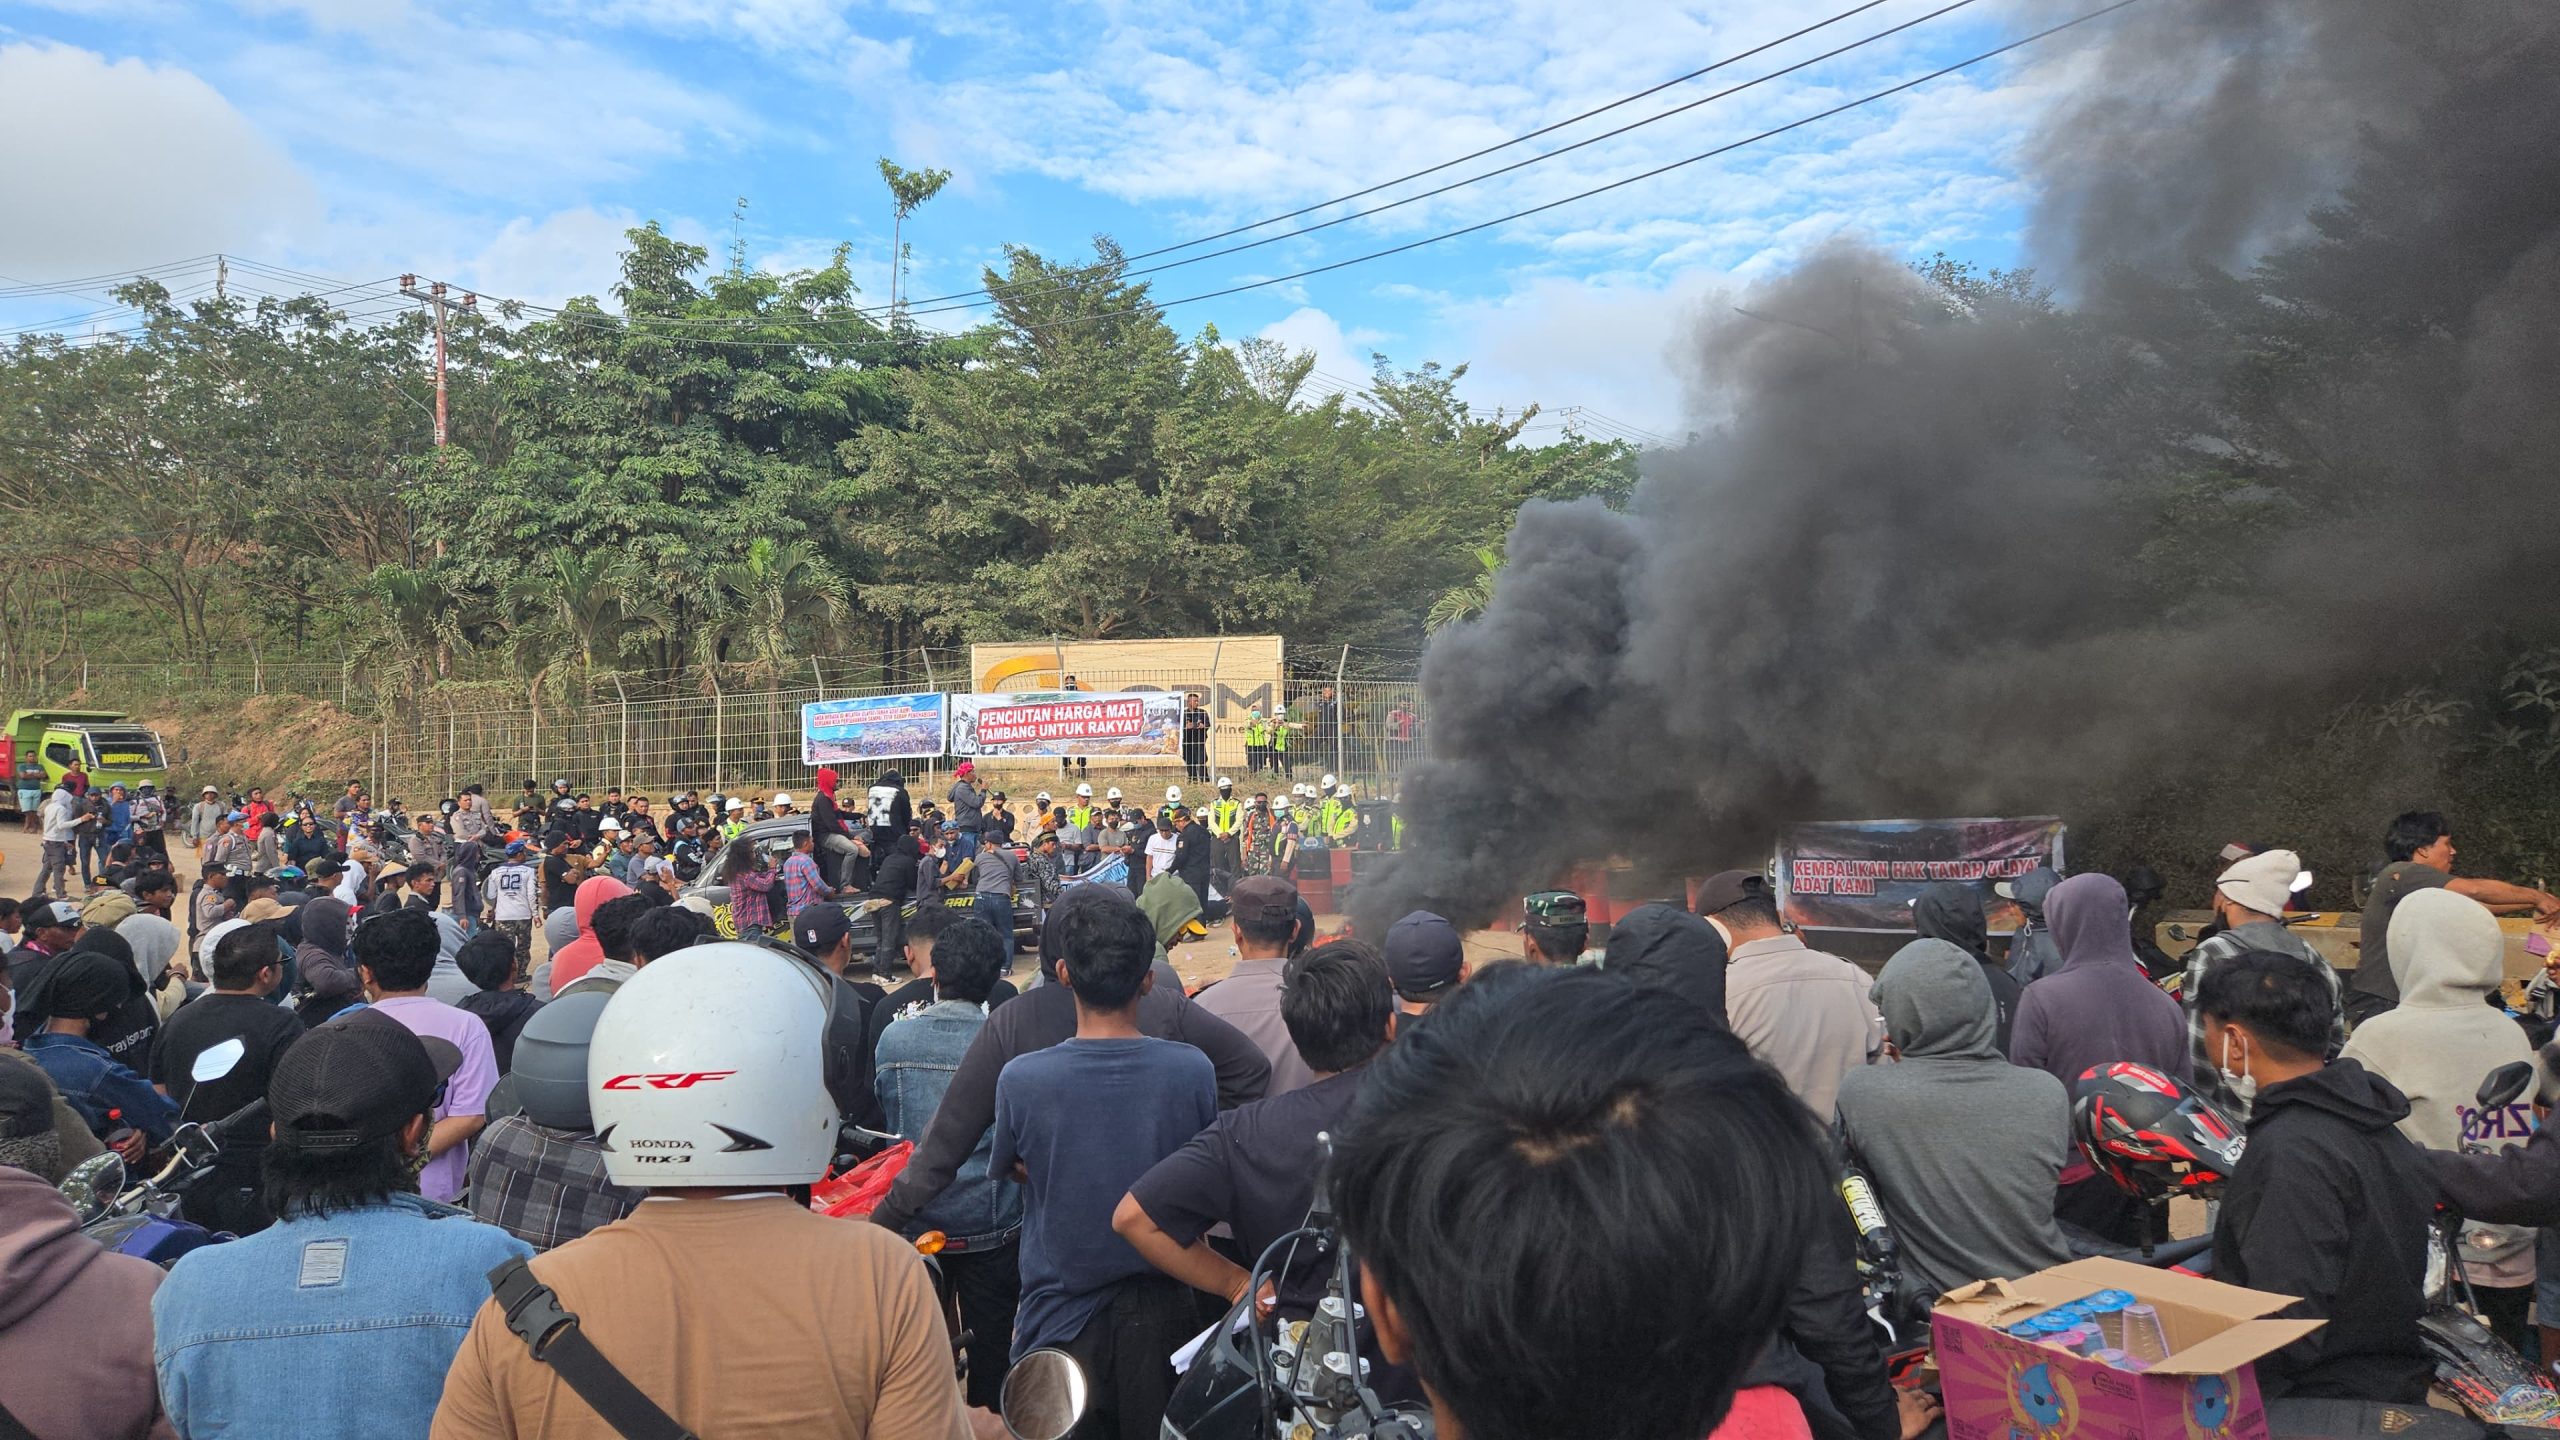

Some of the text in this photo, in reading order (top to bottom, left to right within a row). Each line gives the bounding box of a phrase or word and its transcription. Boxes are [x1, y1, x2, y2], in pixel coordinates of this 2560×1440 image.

[981, 703, 1140, 727] PENCIUTAN HARGA MATI
[979, 719, 1141, 741] TAMBANG UNTUK RAKYAT
[1793, 859, 1889, 878] KEMBALIKAN
[1892, 861, 1927, 879] HAK
[1928, 861, 1984, 880] TANAH
[501, 874, 520, 890] 02
[1793, 877, 1875, 895] ADAT KAMI
[601, 1070, 738, 1090] CRF
[629, 1139, 695, 1149] HONDA
[634, 1155, 692, 1163] TRX-3
